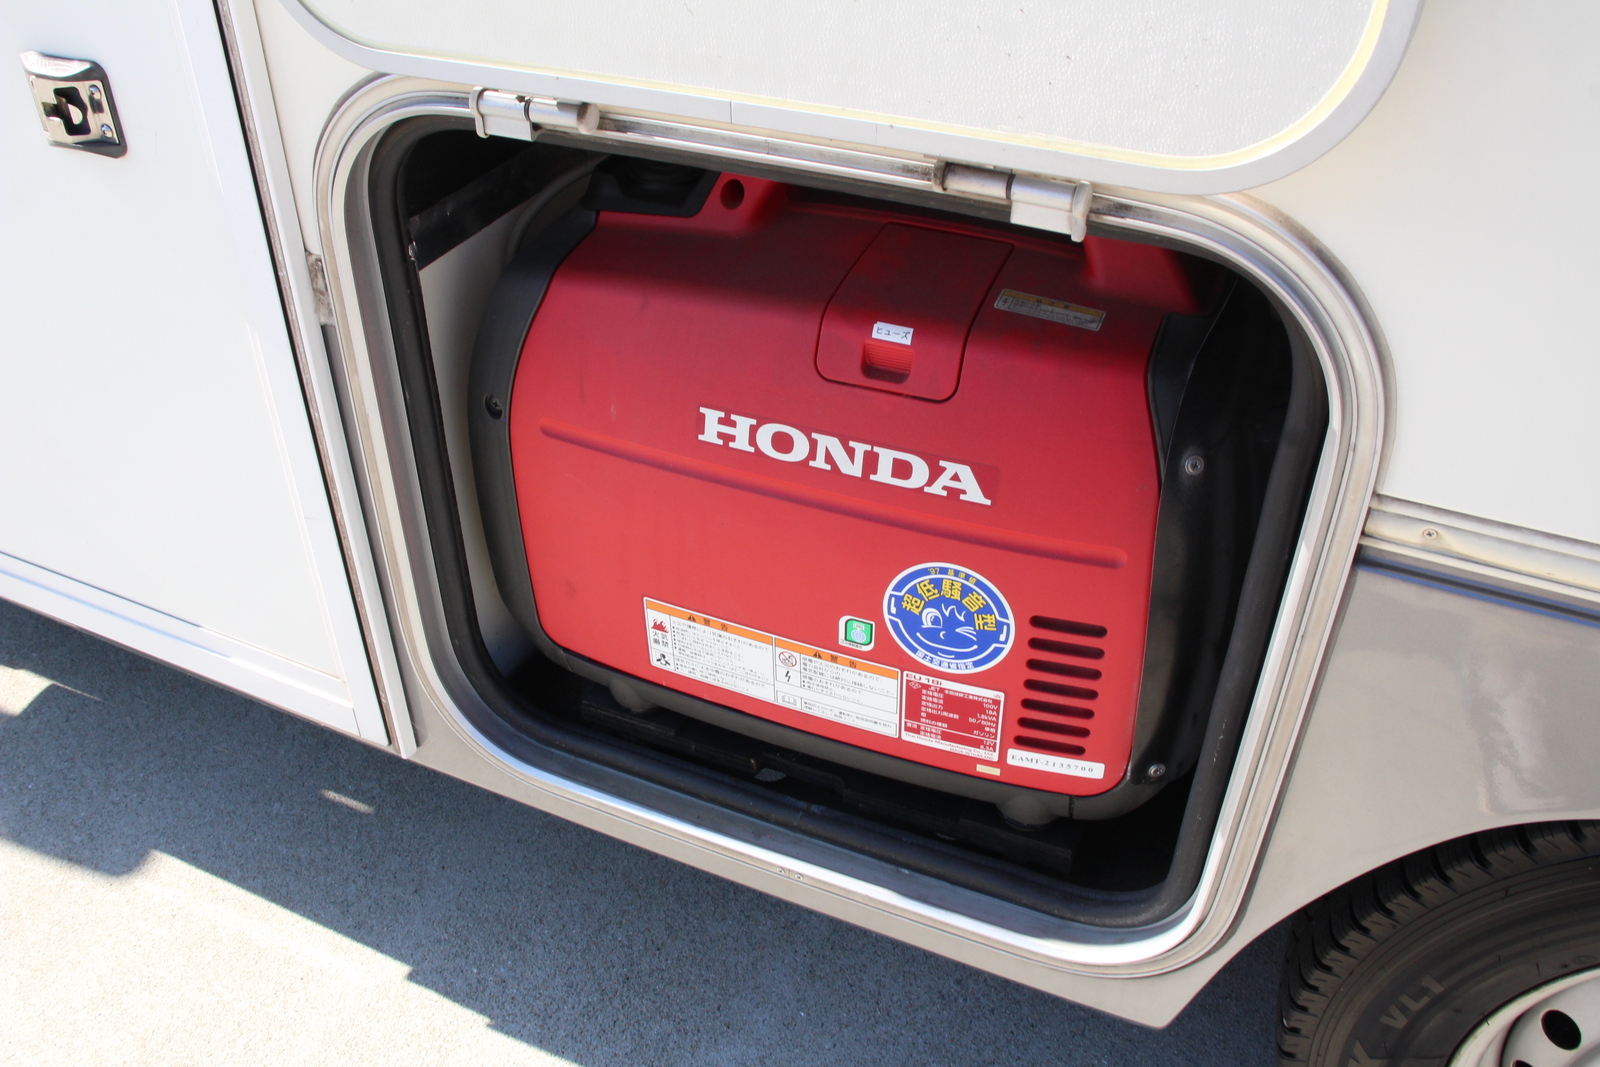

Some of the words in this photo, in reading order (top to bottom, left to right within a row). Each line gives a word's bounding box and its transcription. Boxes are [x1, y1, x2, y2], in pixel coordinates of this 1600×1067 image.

[876, 326, 911, 340] ヒューズ
[698, 406, 991, 506] HONDA
[901, 579, 997, 631] 超低騒音型
[651, 630, 668, 641] 火気
[982, 702, 998, 710] 100V
